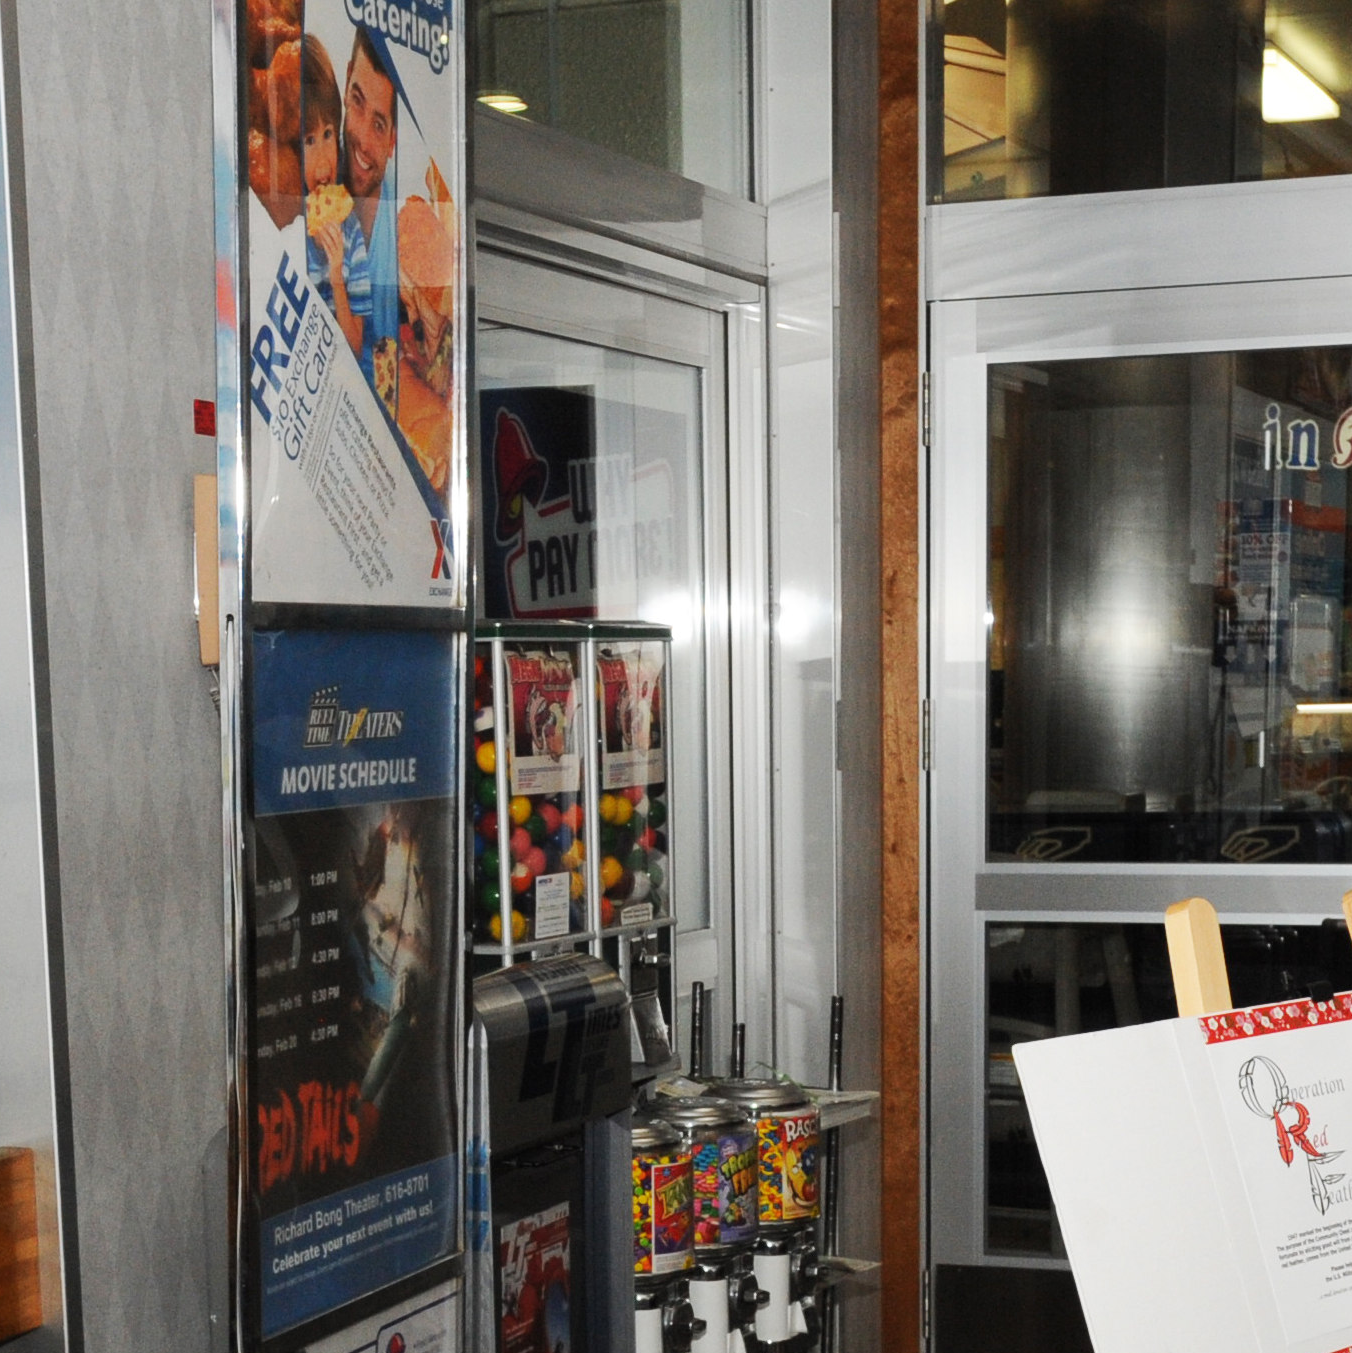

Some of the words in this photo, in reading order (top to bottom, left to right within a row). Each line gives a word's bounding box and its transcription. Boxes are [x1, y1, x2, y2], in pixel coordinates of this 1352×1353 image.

[250, 249, 310, 427] FREE
[271, 399, 290, 442] $10
[285, 302, 320, 400] Exchange
[284, 395, 312, 461] Gift
[304, 314, 334, 394] Card
[1263, 402, 1320, 471] in
[528, 532, 579, 602] PAY
[307, 727, 331, 744] TIME
[310, 708, 336, 725] REEL
[281, 764, 336, 795] MOVIE
[339, 757, 417, 789] SCHEDULE
[327, 870, 338, 884] PM
[327, 908, 338, 922] PM
[328, 947, 339, 961] PM
[328, 985, 340, 1000] PM
[327, 1024, 338, 1038] PM
[298, 1079, 361, 1174] TAILS
[275, 1212, 313, 1246] Richard
[315, 1207, 343, 1230] Bong
[344, 1192, 384, 1218] Theater,
[385, 1173, 429, 1204] 616-8701
[272, 1243, 321, 1275] Celebrate
[322, 1237, 344, 1258] your
[345, 1228, 367, 1247] next
[368, 1215, 393, 1236] event
[396, 1206, 417, 1225] with
[419, 1199, 434, 1220] us!
